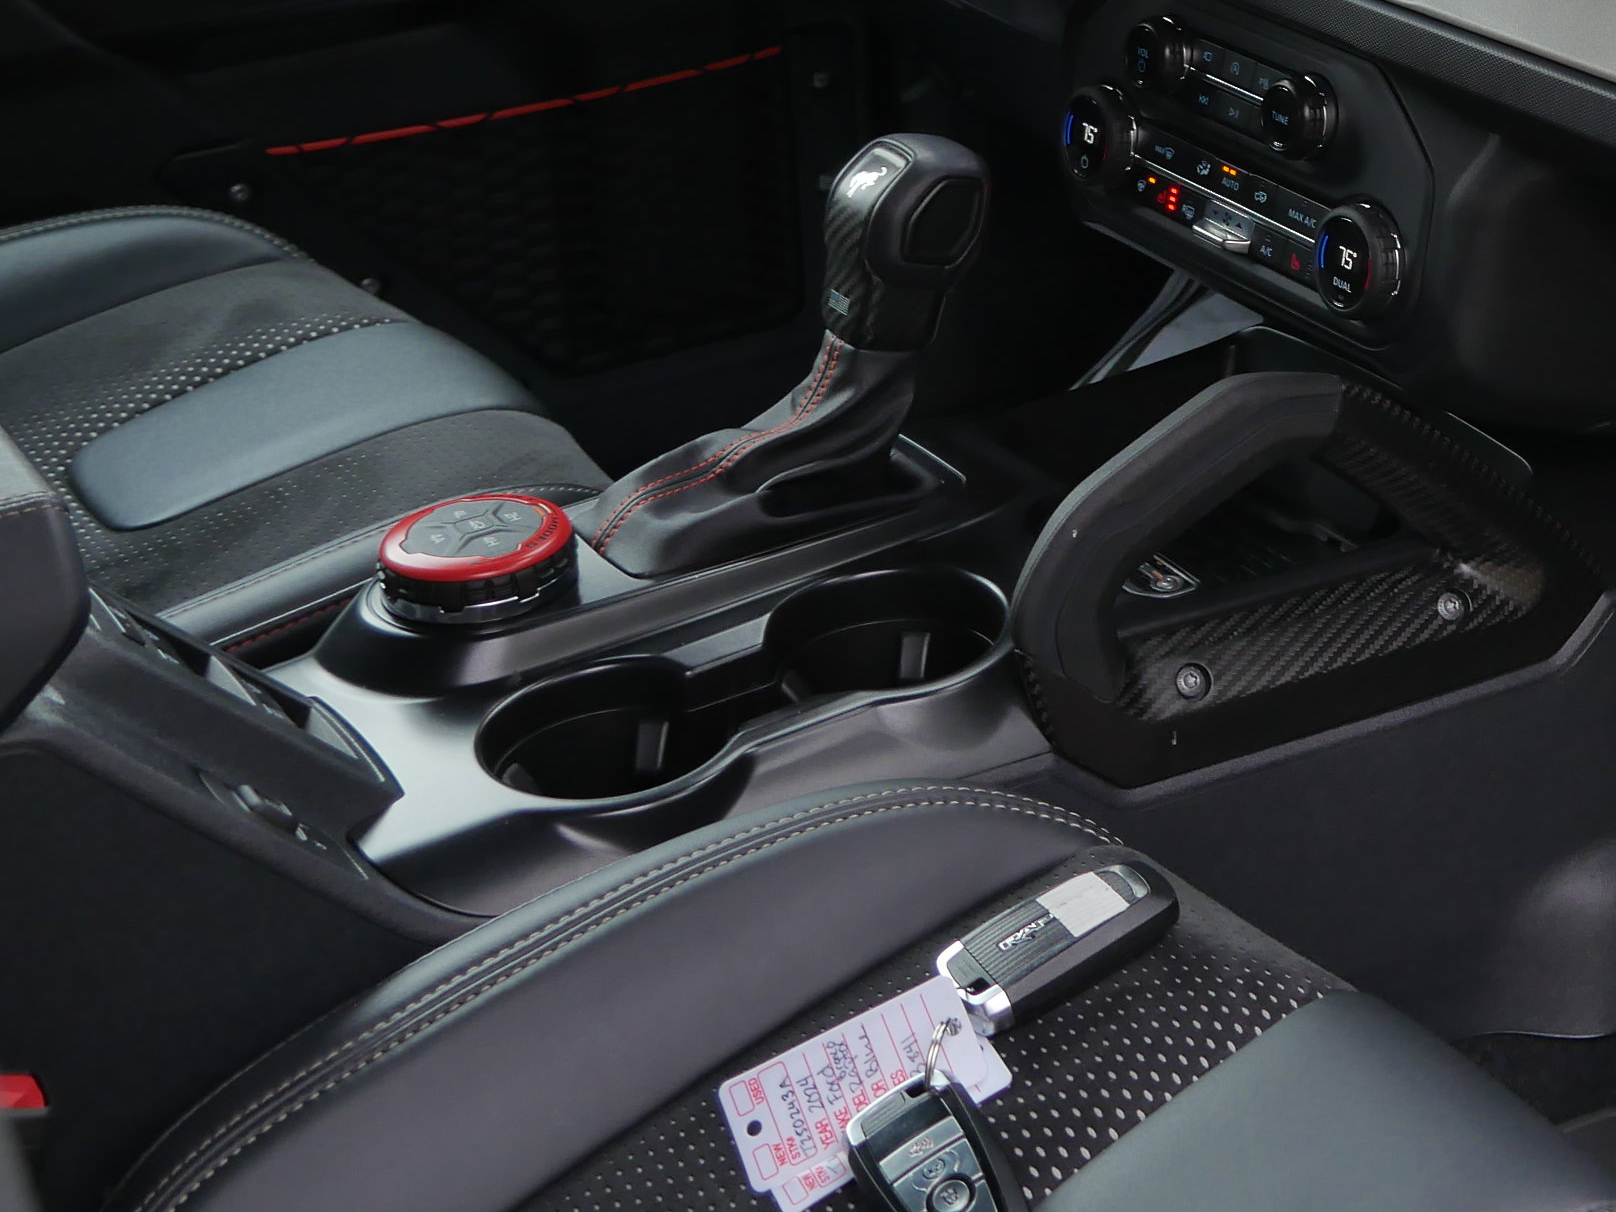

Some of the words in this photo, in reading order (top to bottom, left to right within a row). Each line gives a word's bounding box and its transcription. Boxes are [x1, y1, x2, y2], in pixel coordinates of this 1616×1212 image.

[1137, 46, 1149, 59] VOL
[1271, 109, 1290, 126] TUNE
[1221, 176, 1240, 192] AUTO
[1288, 207, 1304, 224] MAX
[1304, 215, 1317, 230] A/C
[1259, 244, 1273, 258] A/C
[1332, 275, 1353, 294] DUAL
[748, 1077, 766, 1105] USED
[833, 1106, 850, 1131] AKE
[813, 1117, 836, 1150] YEAR
[771, 1142, 788, 1167] NEW
